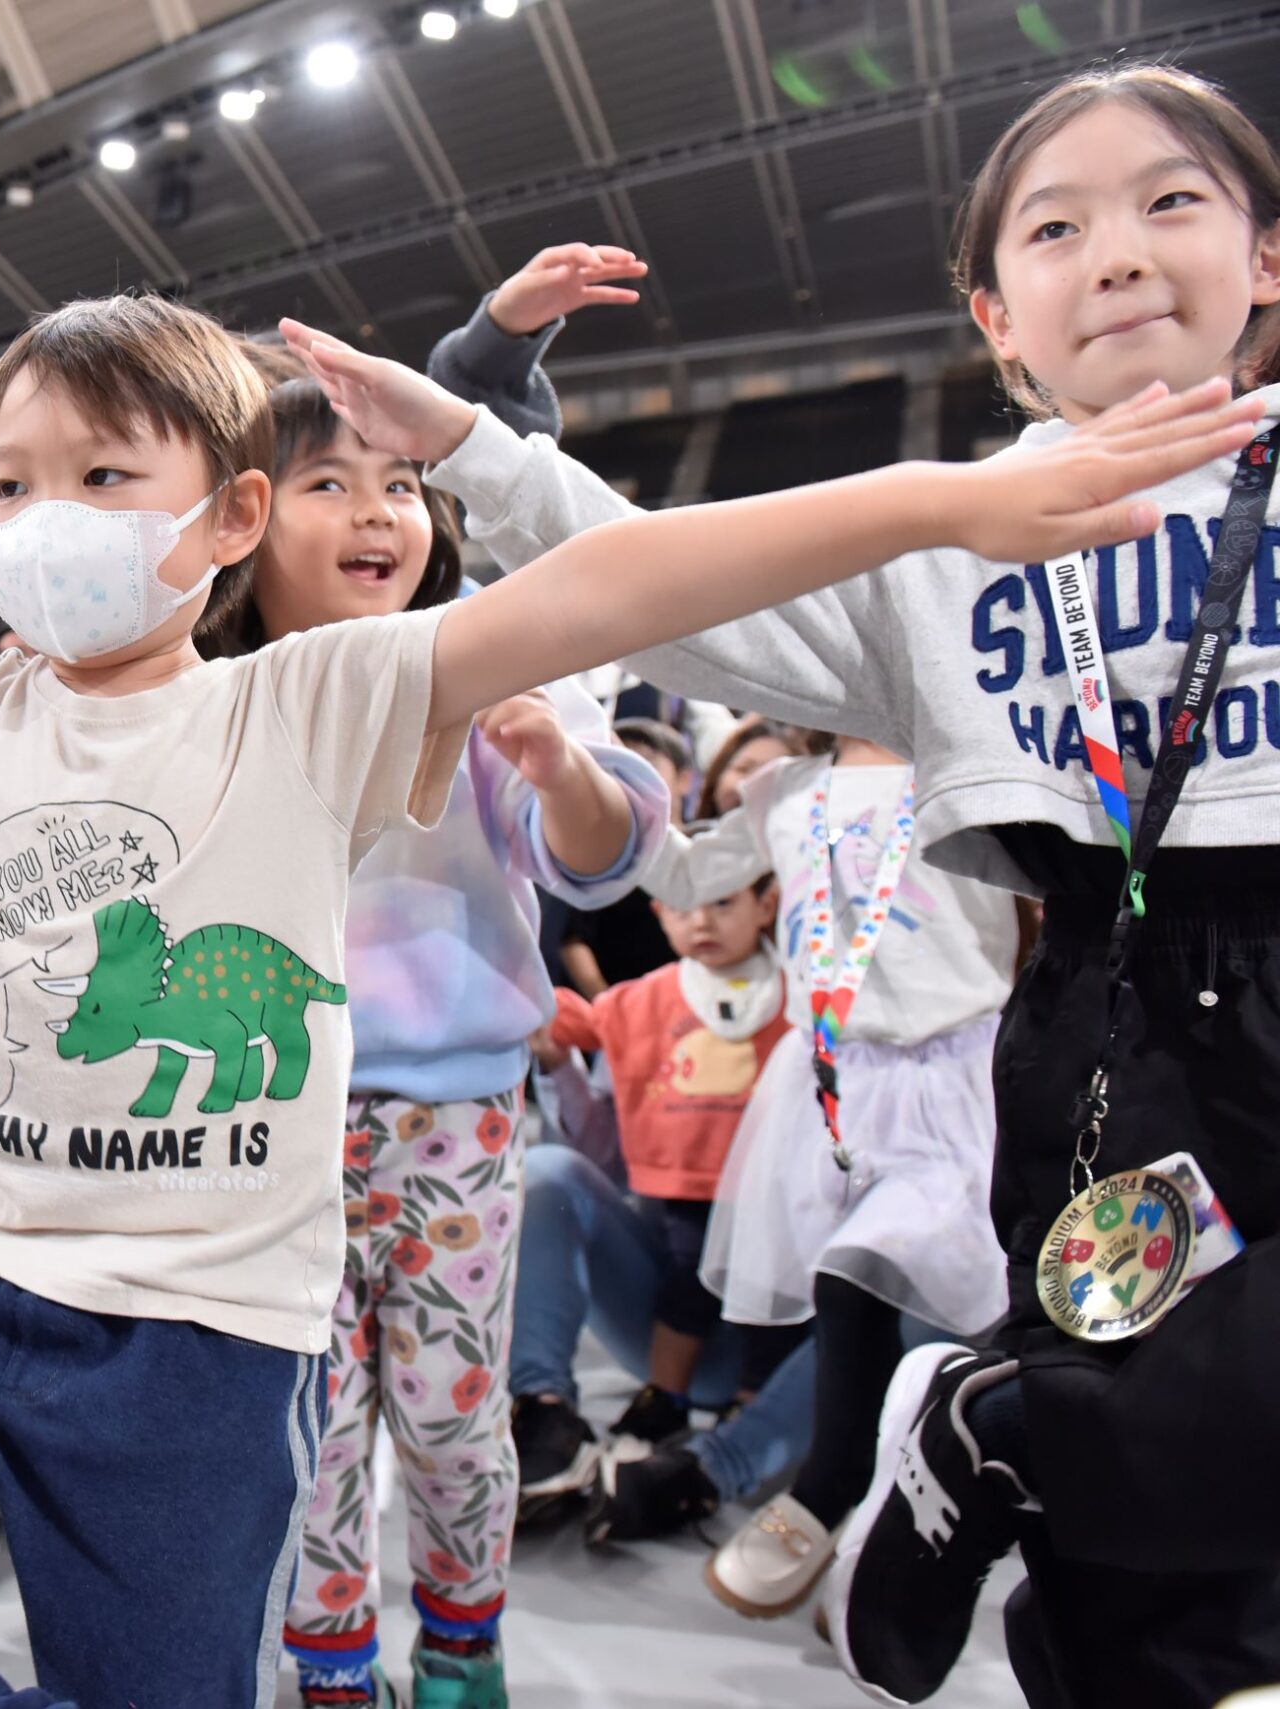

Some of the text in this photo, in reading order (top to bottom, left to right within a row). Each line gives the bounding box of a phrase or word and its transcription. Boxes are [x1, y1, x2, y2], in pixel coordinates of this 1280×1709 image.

[1056, 563, 1096, 674] TEAM BEYOND
[1082, 677, 1099, 712] BEYOND
[1184, 633, 1219, 706] TEAM BEYOND
[1172, 709, 1193, 745] BEYOND
[48, 819, 111, 873] ALL
[56, 857, 125, 912] ME?
[69, 1126, 207, 1172] NAME
[229, 1122, 270, 1167] IS
[1044, 1176, 1138, 1328] BEYOND STADIUM 2024
